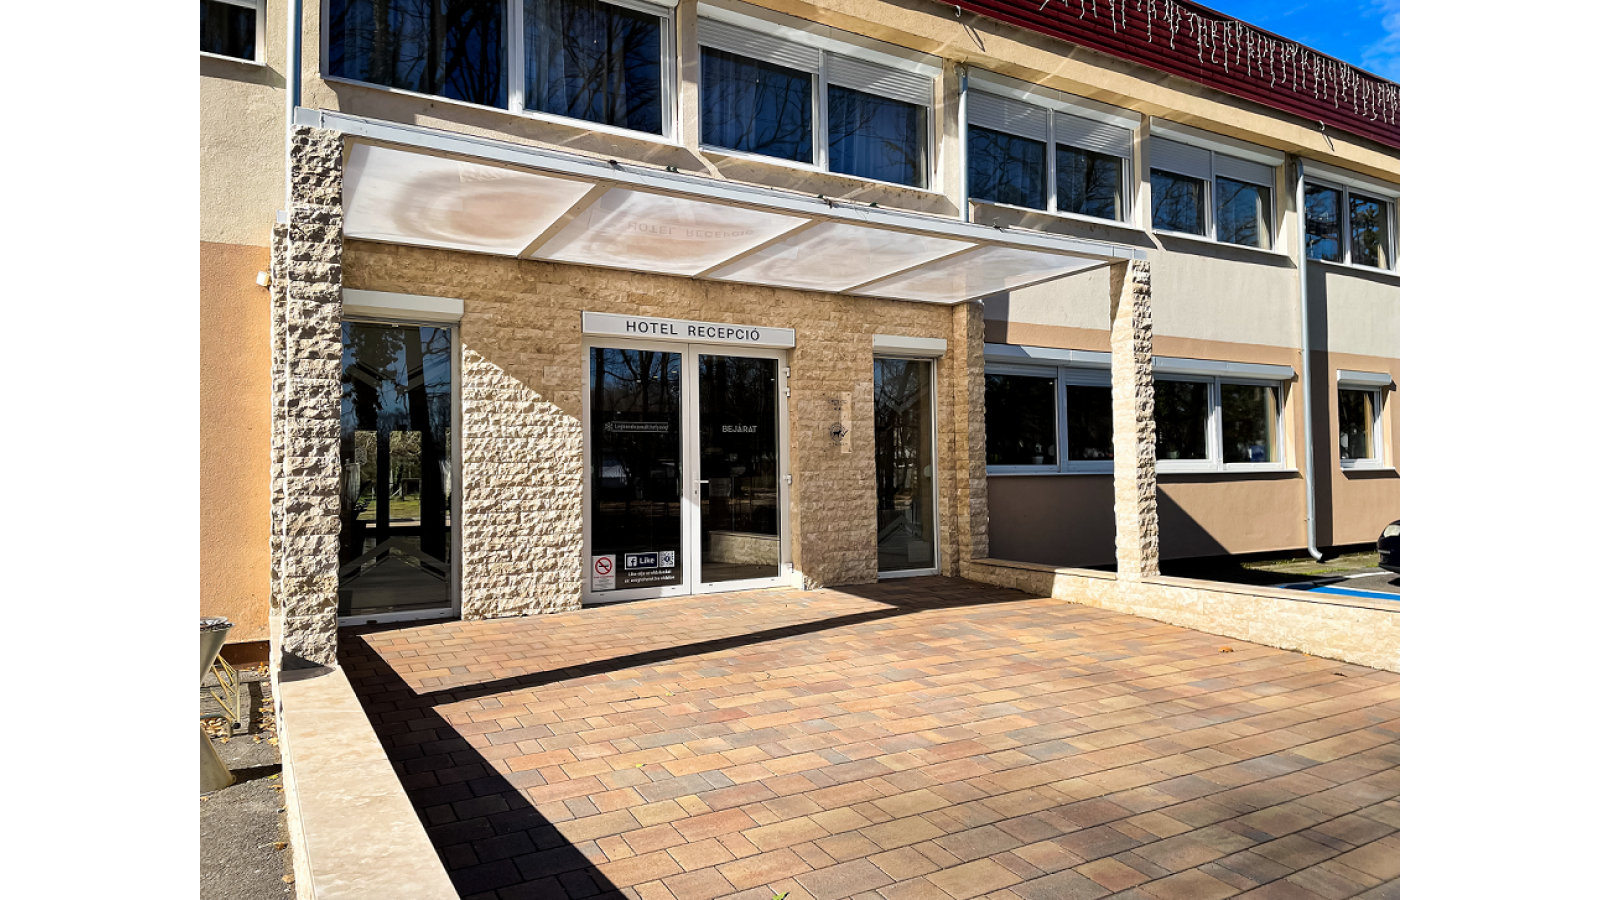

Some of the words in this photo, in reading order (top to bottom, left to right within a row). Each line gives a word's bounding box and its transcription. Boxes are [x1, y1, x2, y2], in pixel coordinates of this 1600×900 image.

[626, 320, 678, 335] HOTEL
[687, 325, 760, 341] RECEPCIÓ
[722, 423, 758, 433] BEJÁRAT
